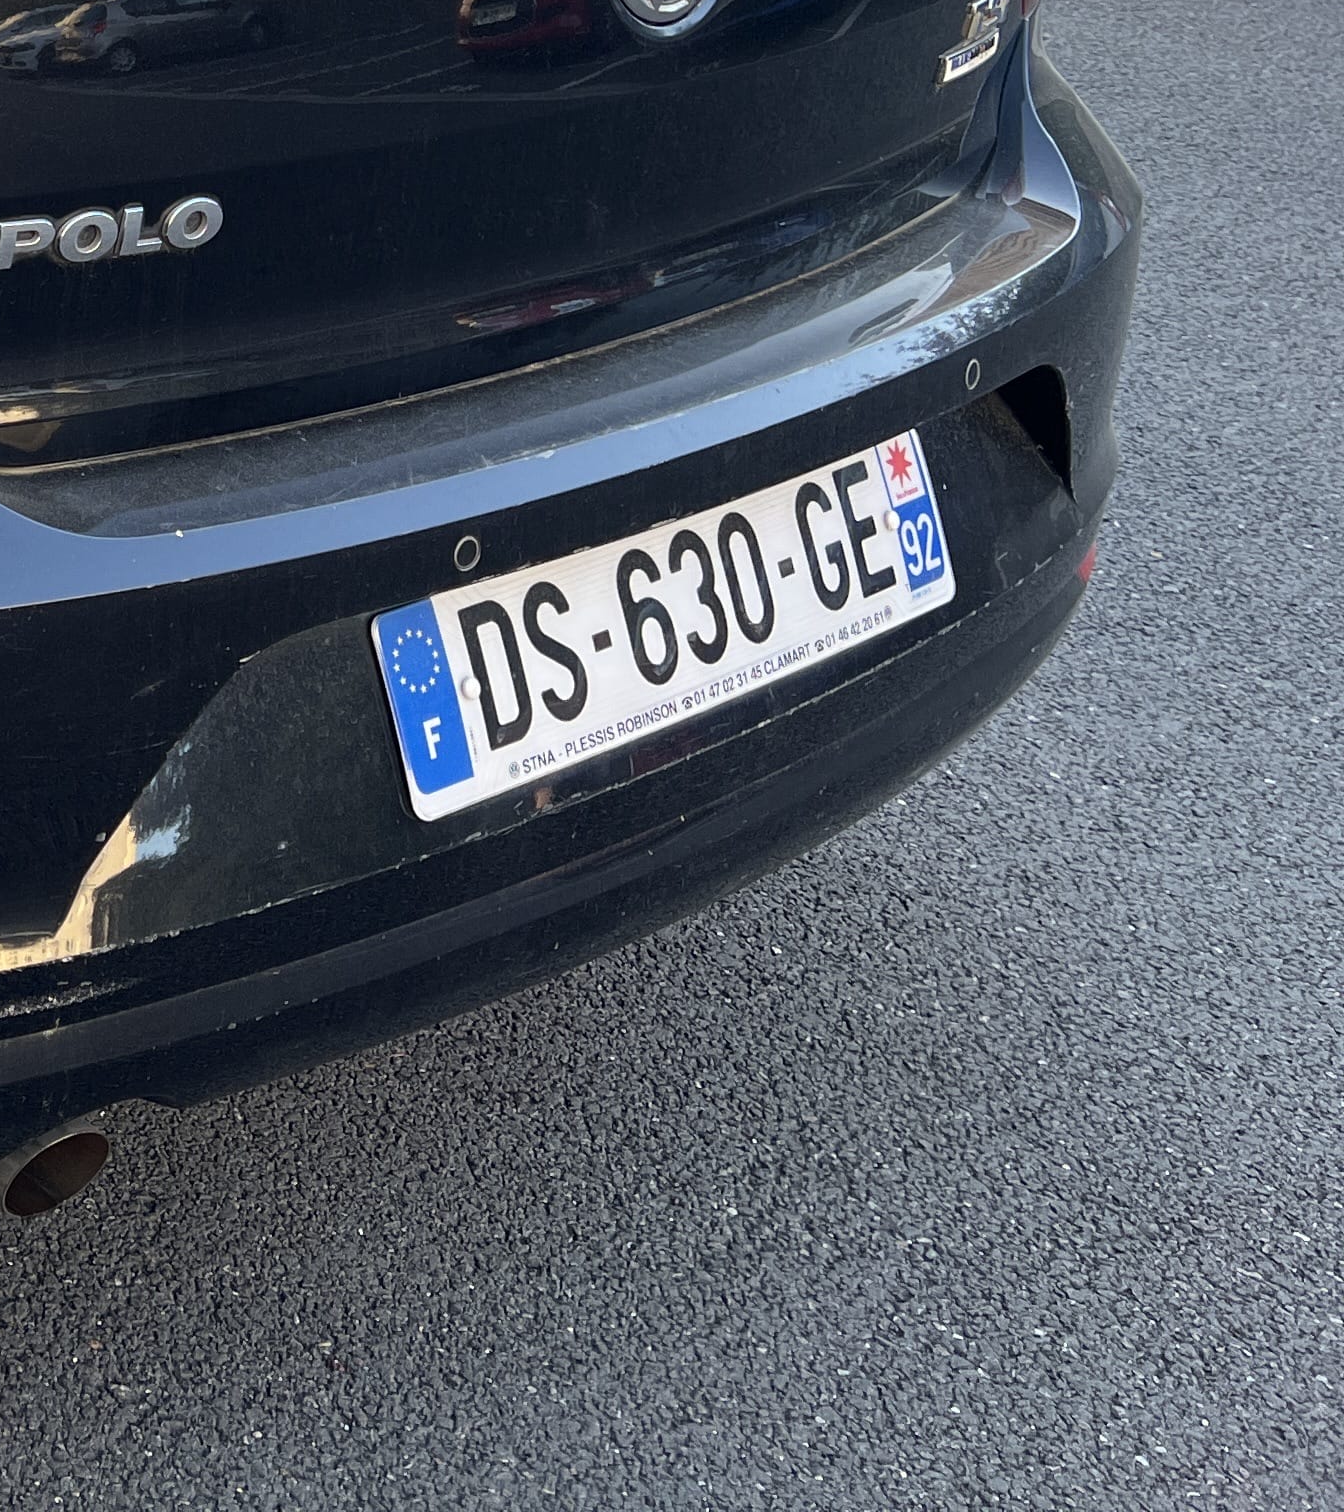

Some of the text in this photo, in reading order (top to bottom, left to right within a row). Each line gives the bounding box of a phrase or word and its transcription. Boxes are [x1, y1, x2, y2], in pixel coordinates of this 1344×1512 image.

[901, 513, 942, 576] 92
[457, 461, 897, 751] DS-630-GE
[423, 716, 441, 760] F
[522, 749, 556, 775] STNA
[565, 726, 615, 757] PLESSIS
[616, 700, 679, 736] ROBINSON
[694, 689, 707, 705] 01
[709, 683, 720, 699] 47
[723, 676, 734, 693] 02
[737, 670, 748, 687] 31
[750, 664, 763, 680] 45
[764, 643, 811, 675] CLAMART
[825, 632, 836, 648] 01
[862, 615, 874, 632] 20
